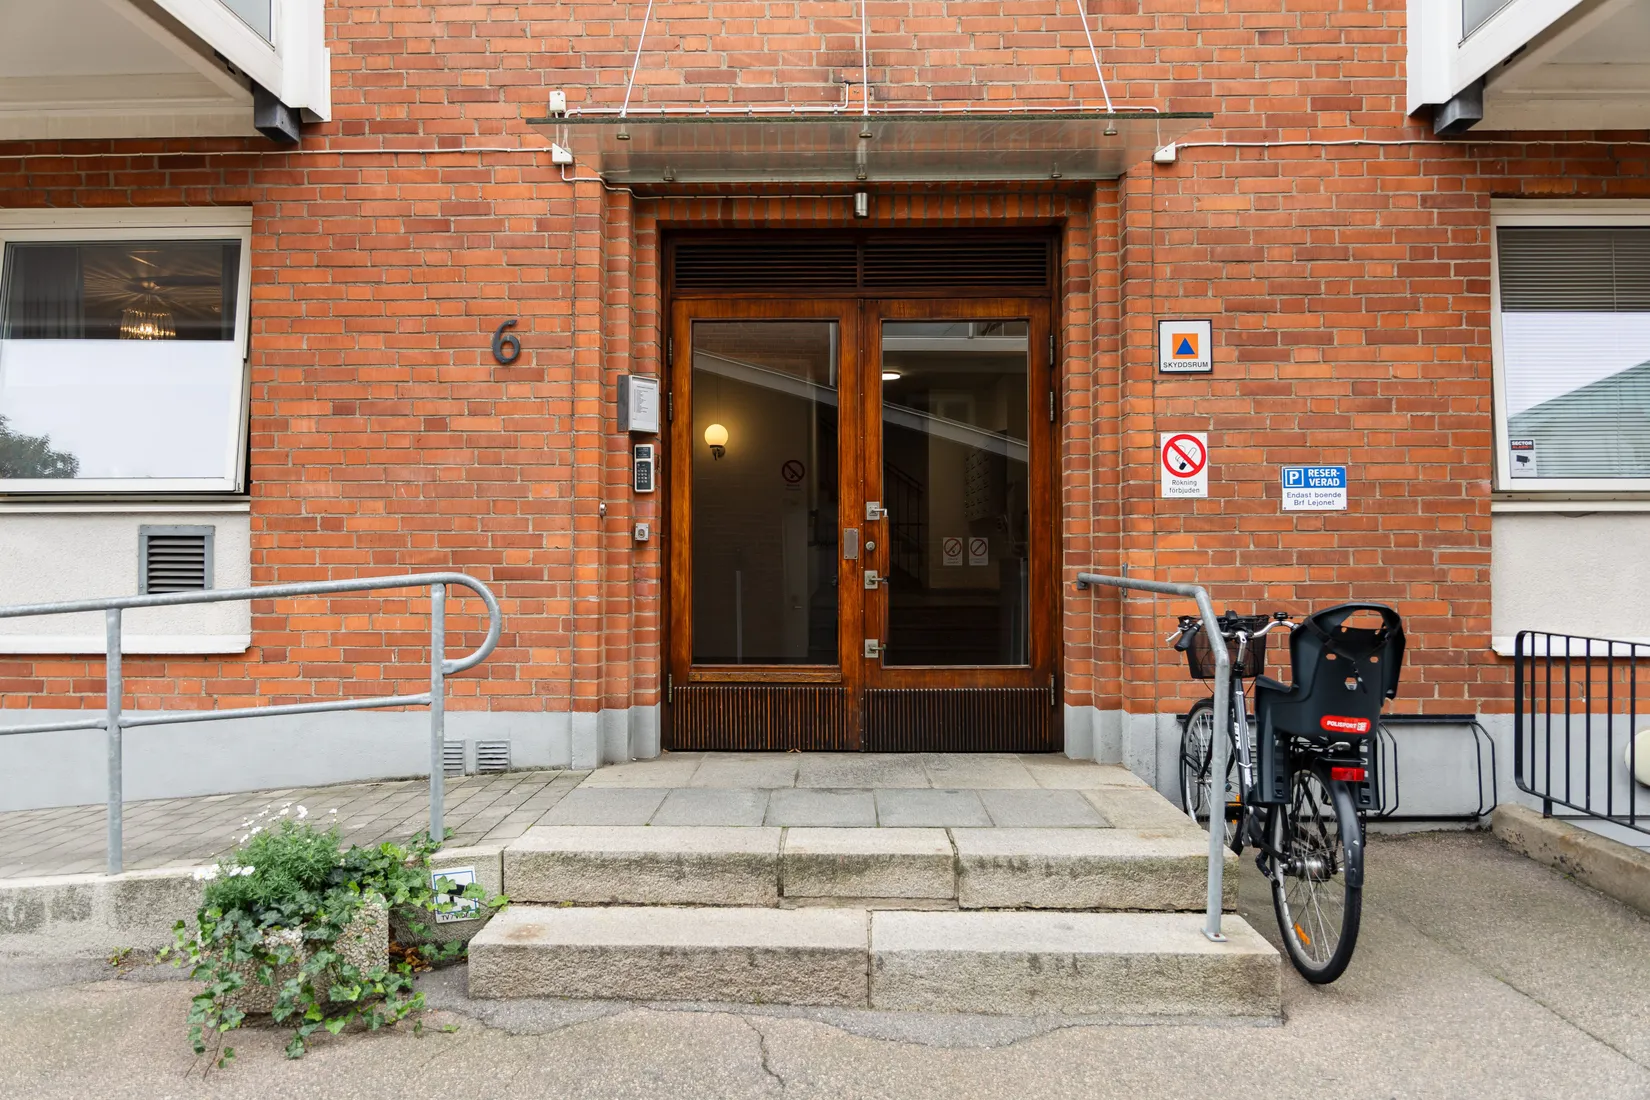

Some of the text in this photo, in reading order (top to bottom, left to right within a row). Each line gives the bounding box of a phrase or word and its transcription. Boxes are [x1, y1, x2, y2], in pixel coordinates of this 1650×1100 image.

[493, 319, 520, 364] 6
[1308, 468, 1340, 477] RESER-
[1289, 471, 1299, 484] P
[1309, 478, 1340, 487] VERAD
[1326, 720, 1357, 729] POLISPORT
